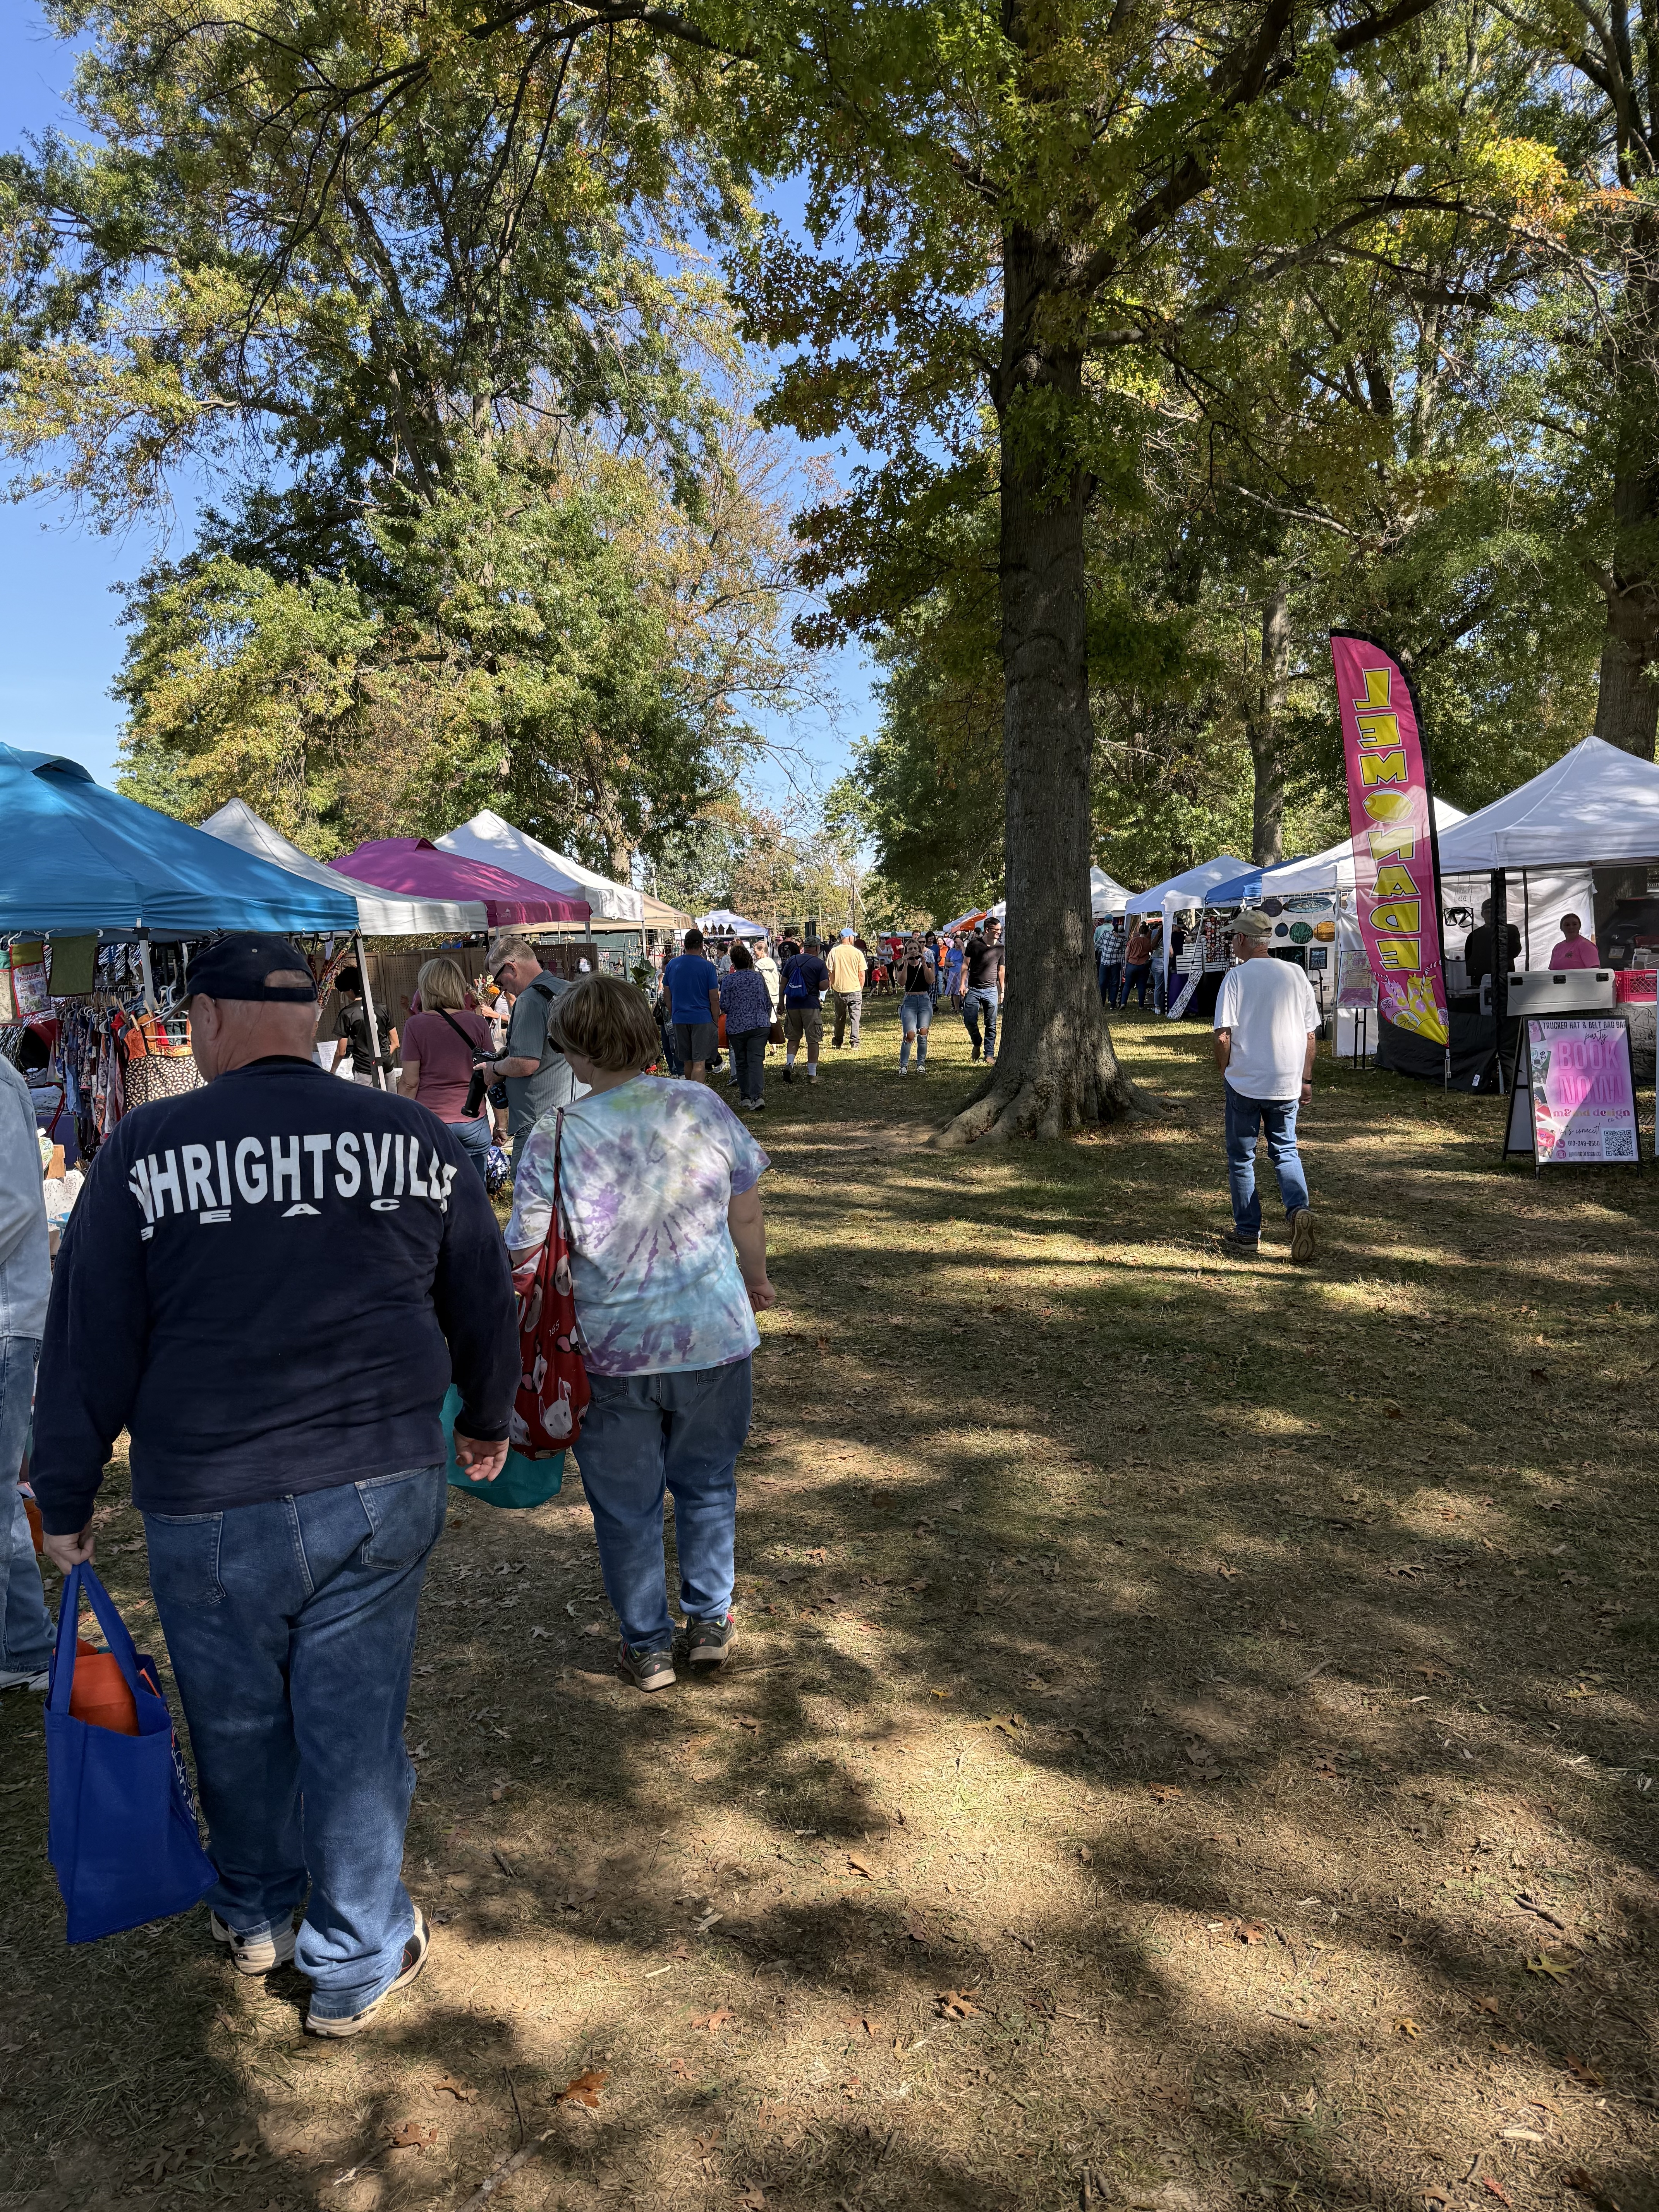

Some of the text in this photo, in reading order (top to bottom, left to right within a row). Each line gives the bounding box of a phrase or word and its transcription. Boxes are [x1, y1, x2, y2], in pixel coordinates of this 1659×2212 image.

[1583, 1029, 1608, 1045] party
[1558, 1041, 1620, 1070] BOOK
[1558, 1075, 1623, 1104] NOW!
